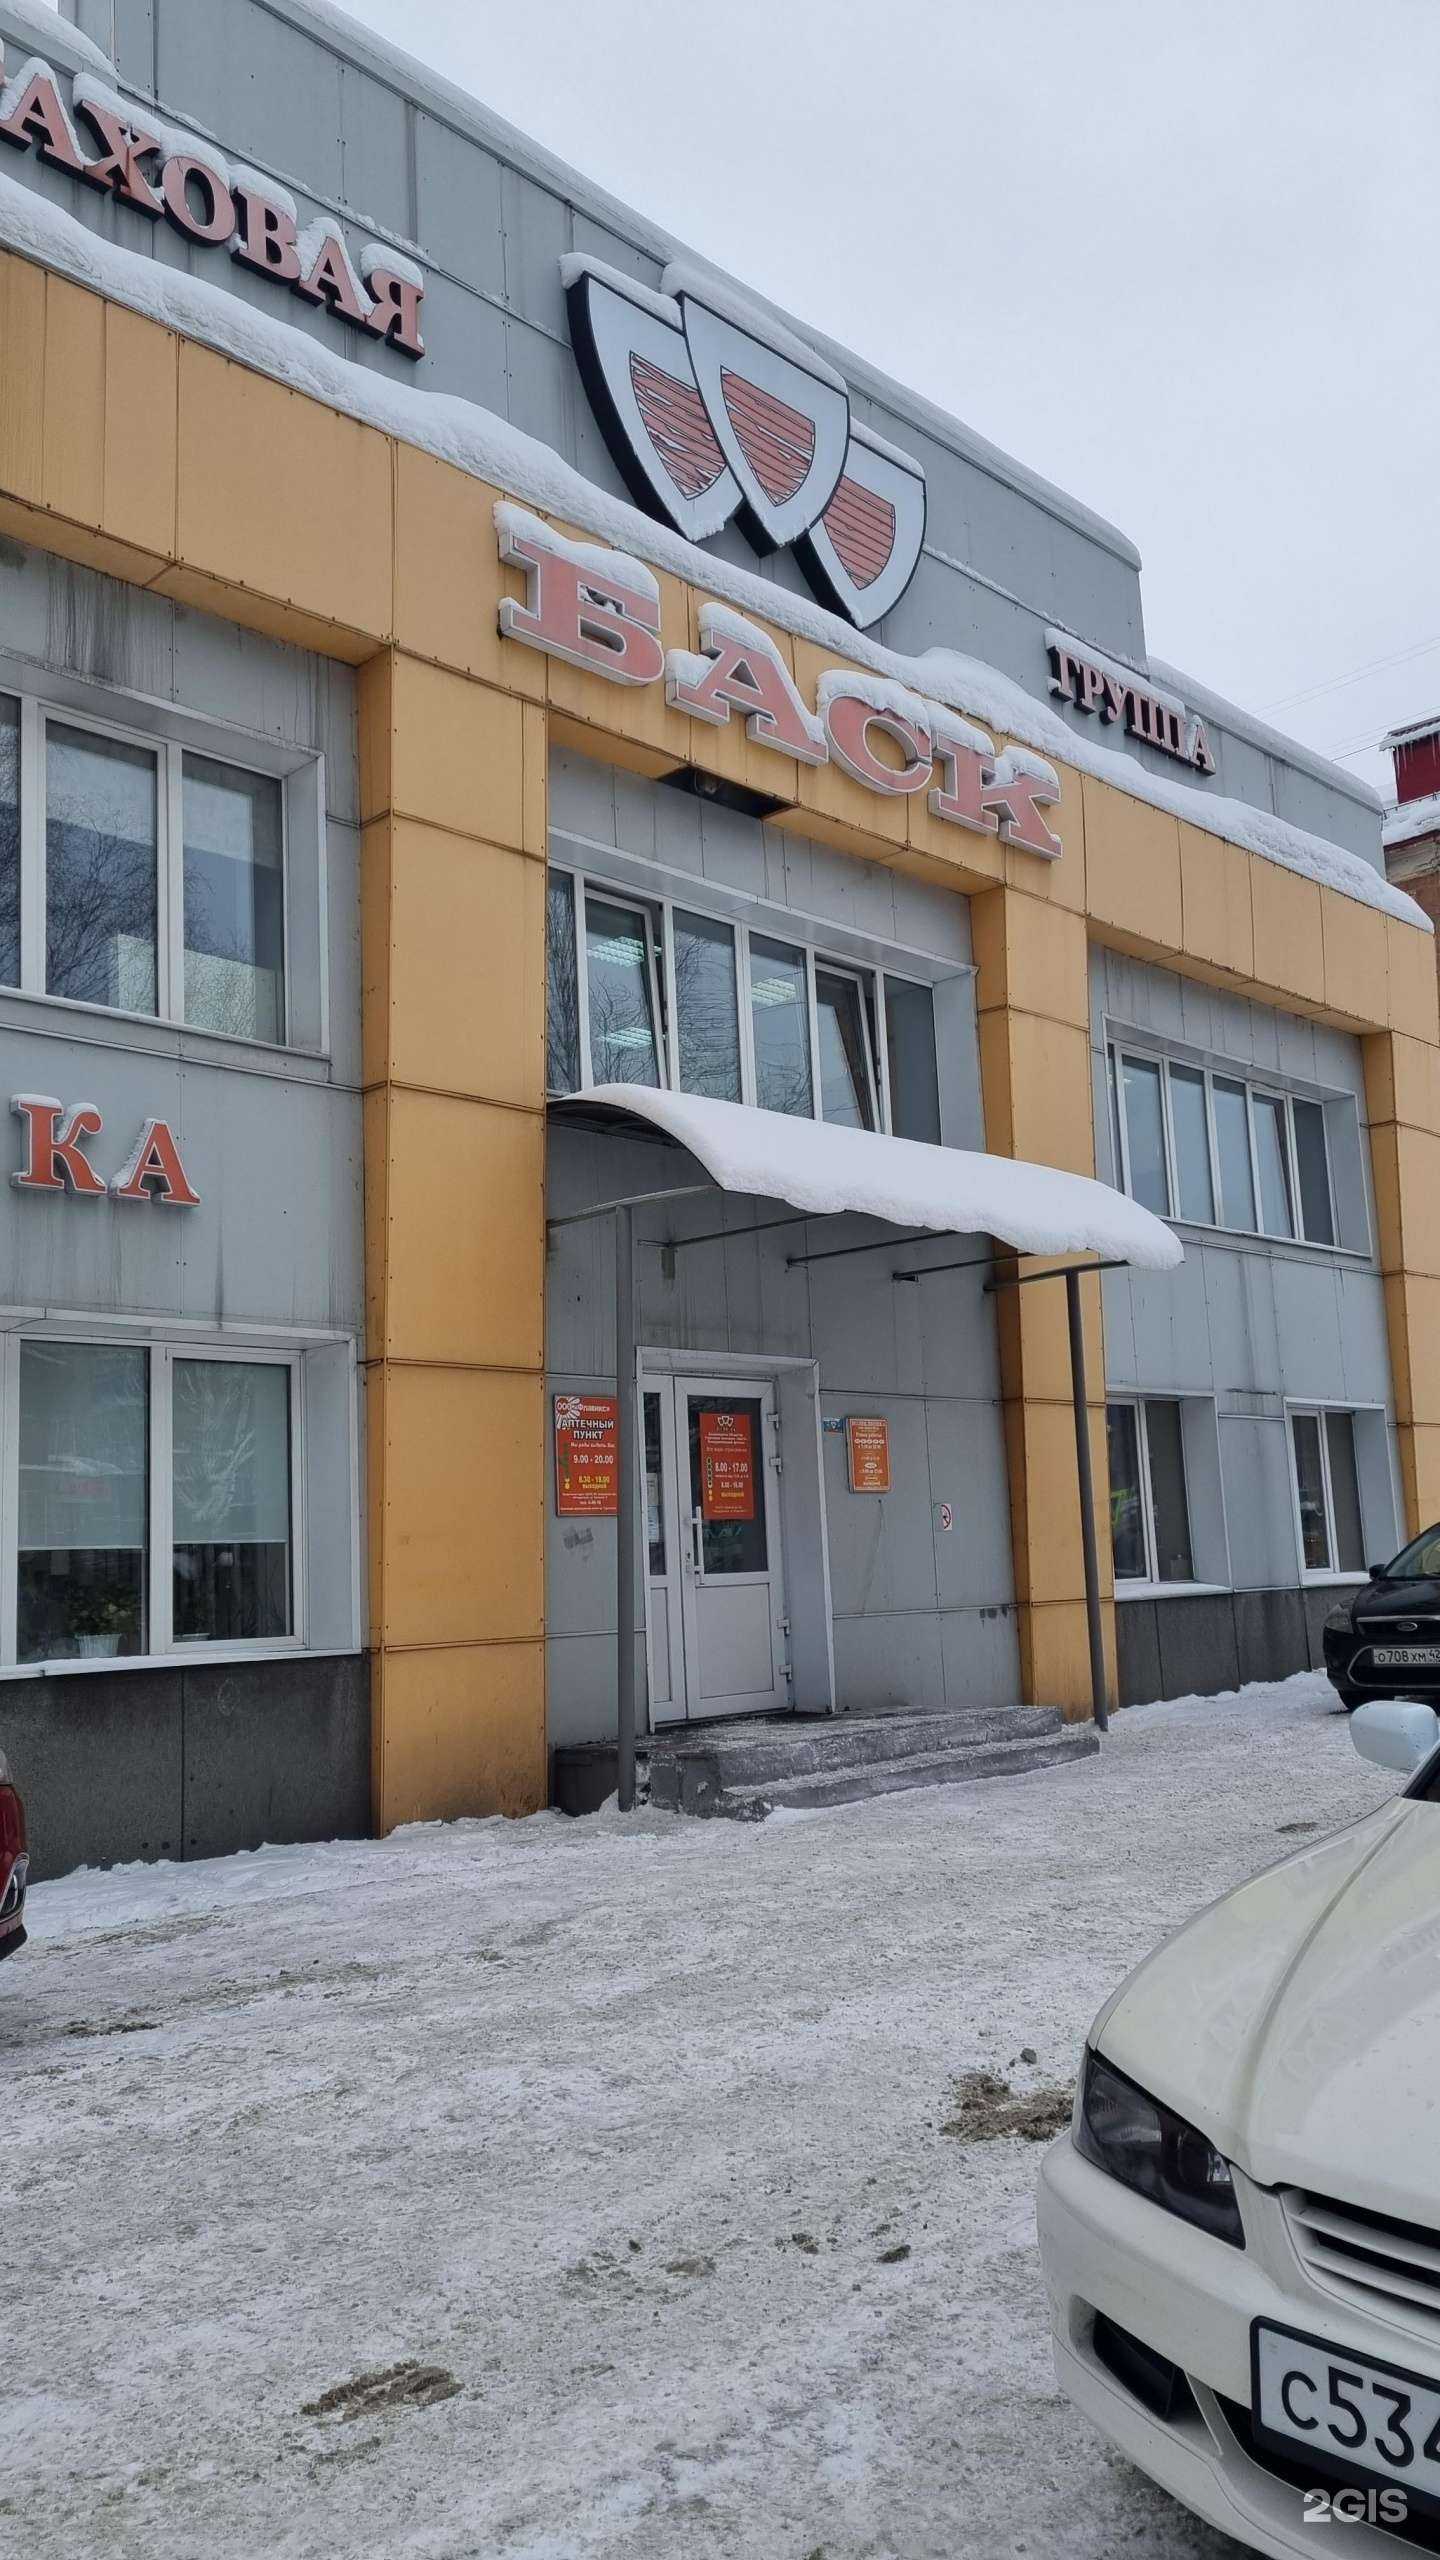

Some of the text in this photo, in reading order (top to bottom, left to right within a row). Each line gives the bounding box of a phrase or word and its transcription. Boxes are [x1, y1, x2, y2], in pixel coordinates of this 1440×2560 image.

[0, 62, 425, 360] АХОВАЯ
[499, 532, 1063, 860] БАСК
[1047, 645, 1216, 776] ГРУППА
[562, 1418, 614, 1429] АПТЕЧНЫЙ
[573, 1430, 604, 1440] ПУНКТ
[573, 1454, 589, 1464] 9.00
[594, 1455, 614, 1465] 20.00
[732, 1462, 748, 1473] 17.00
